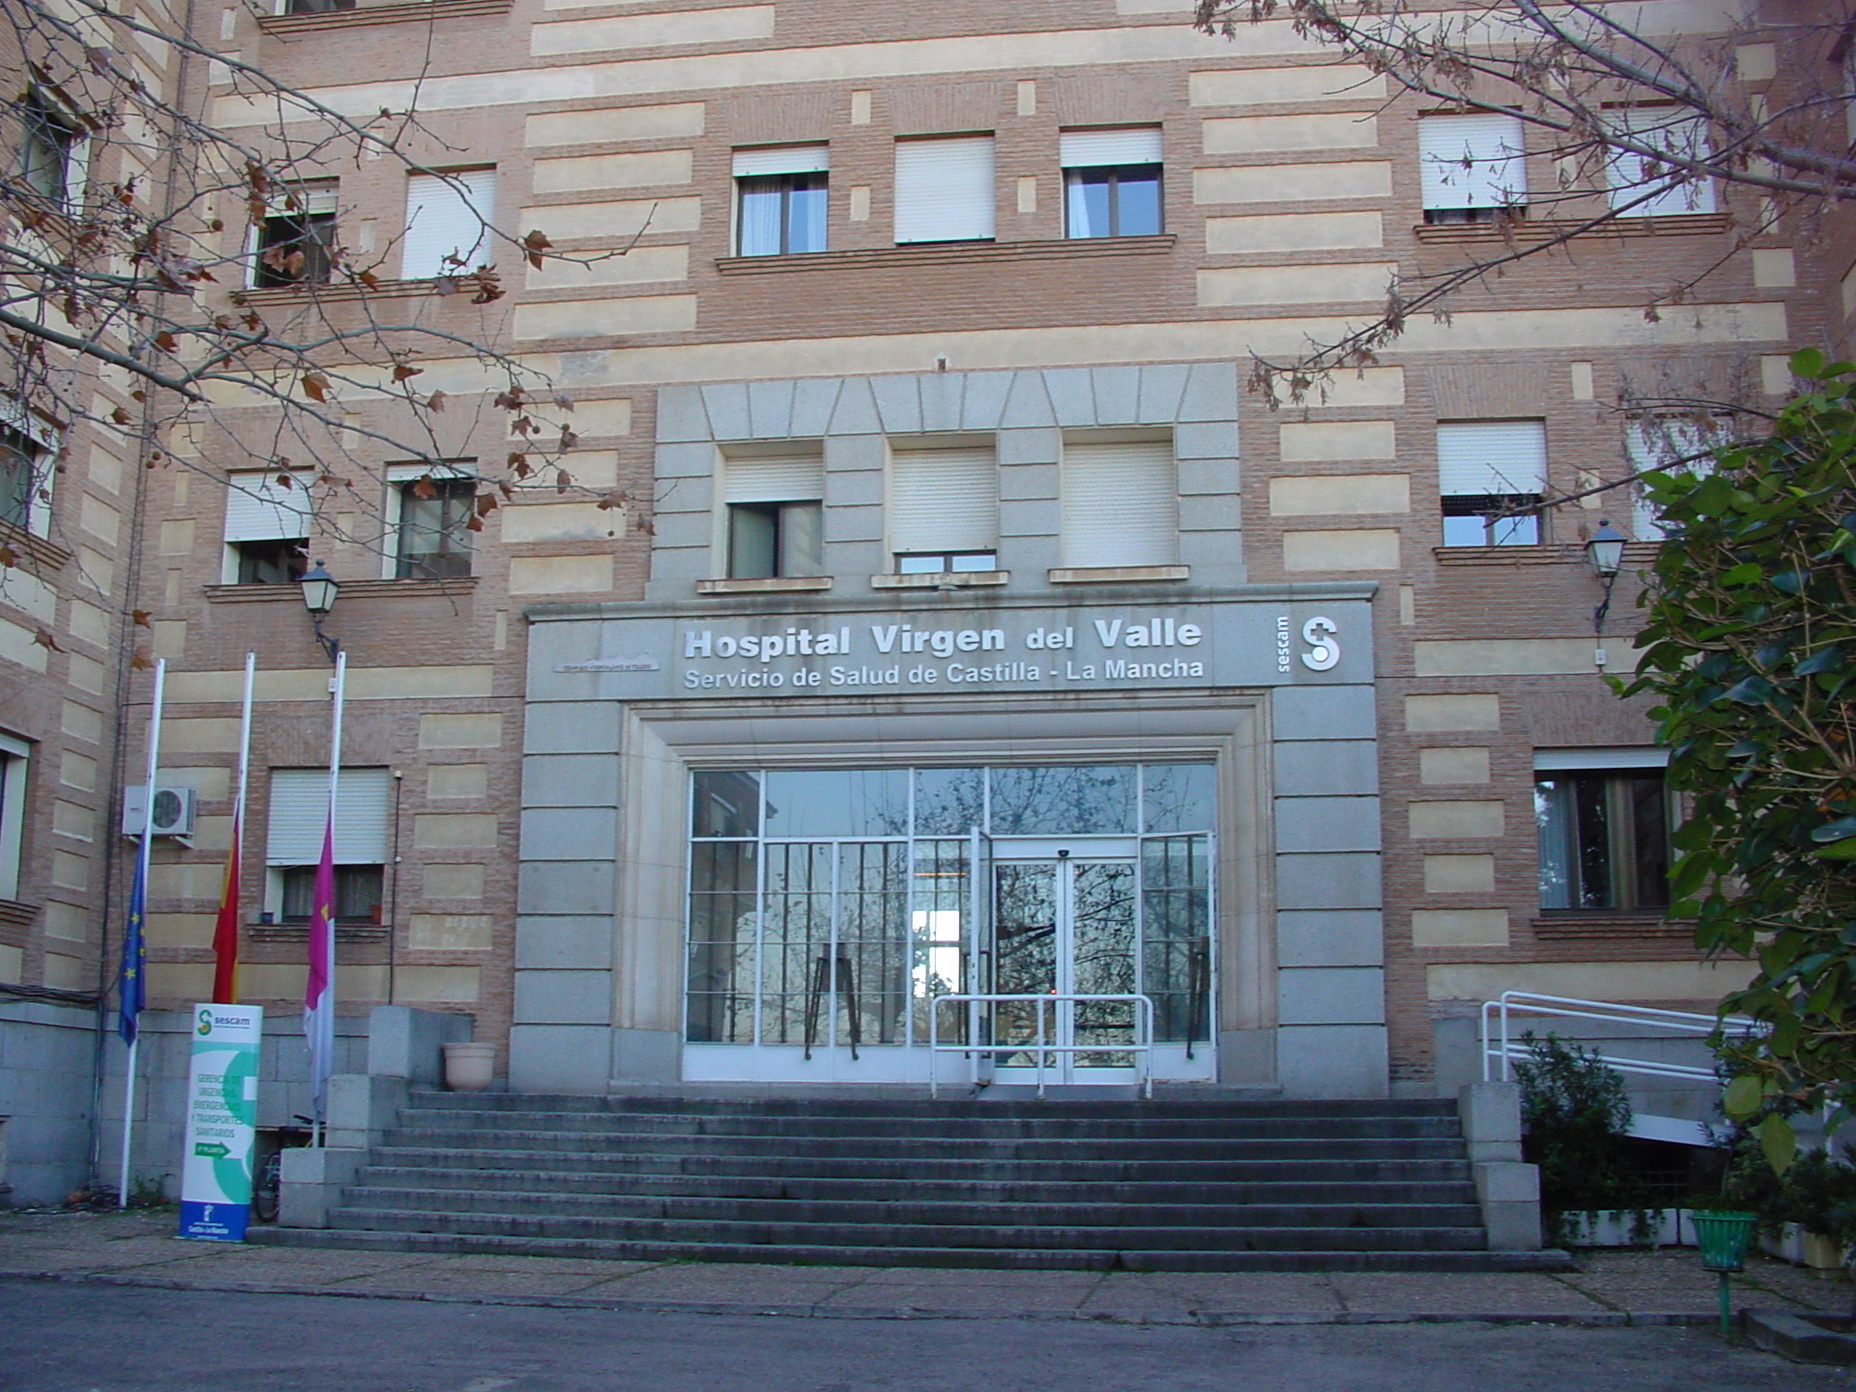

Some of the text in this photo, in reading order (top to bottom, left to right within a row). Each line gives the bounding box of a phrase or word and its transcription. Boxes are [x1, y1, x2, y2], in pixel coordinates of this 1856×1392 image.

[684, 617, 1203, 663] Hospital Virgen del Valle
[1277, 616, 1290, 673] sescam
[684, 668, 784, 689] Servicio
[792, 667, 821, 687] de
[830, 664, 900, 686] Salud
[908, 665, 938, 684] de
[946, 661, 1040, 683] Castilla
[1066, 660, 1095, 681] La
[1105, 658, 1204, 680] Mancha
[214, 1016, 250, 1026] sescam
